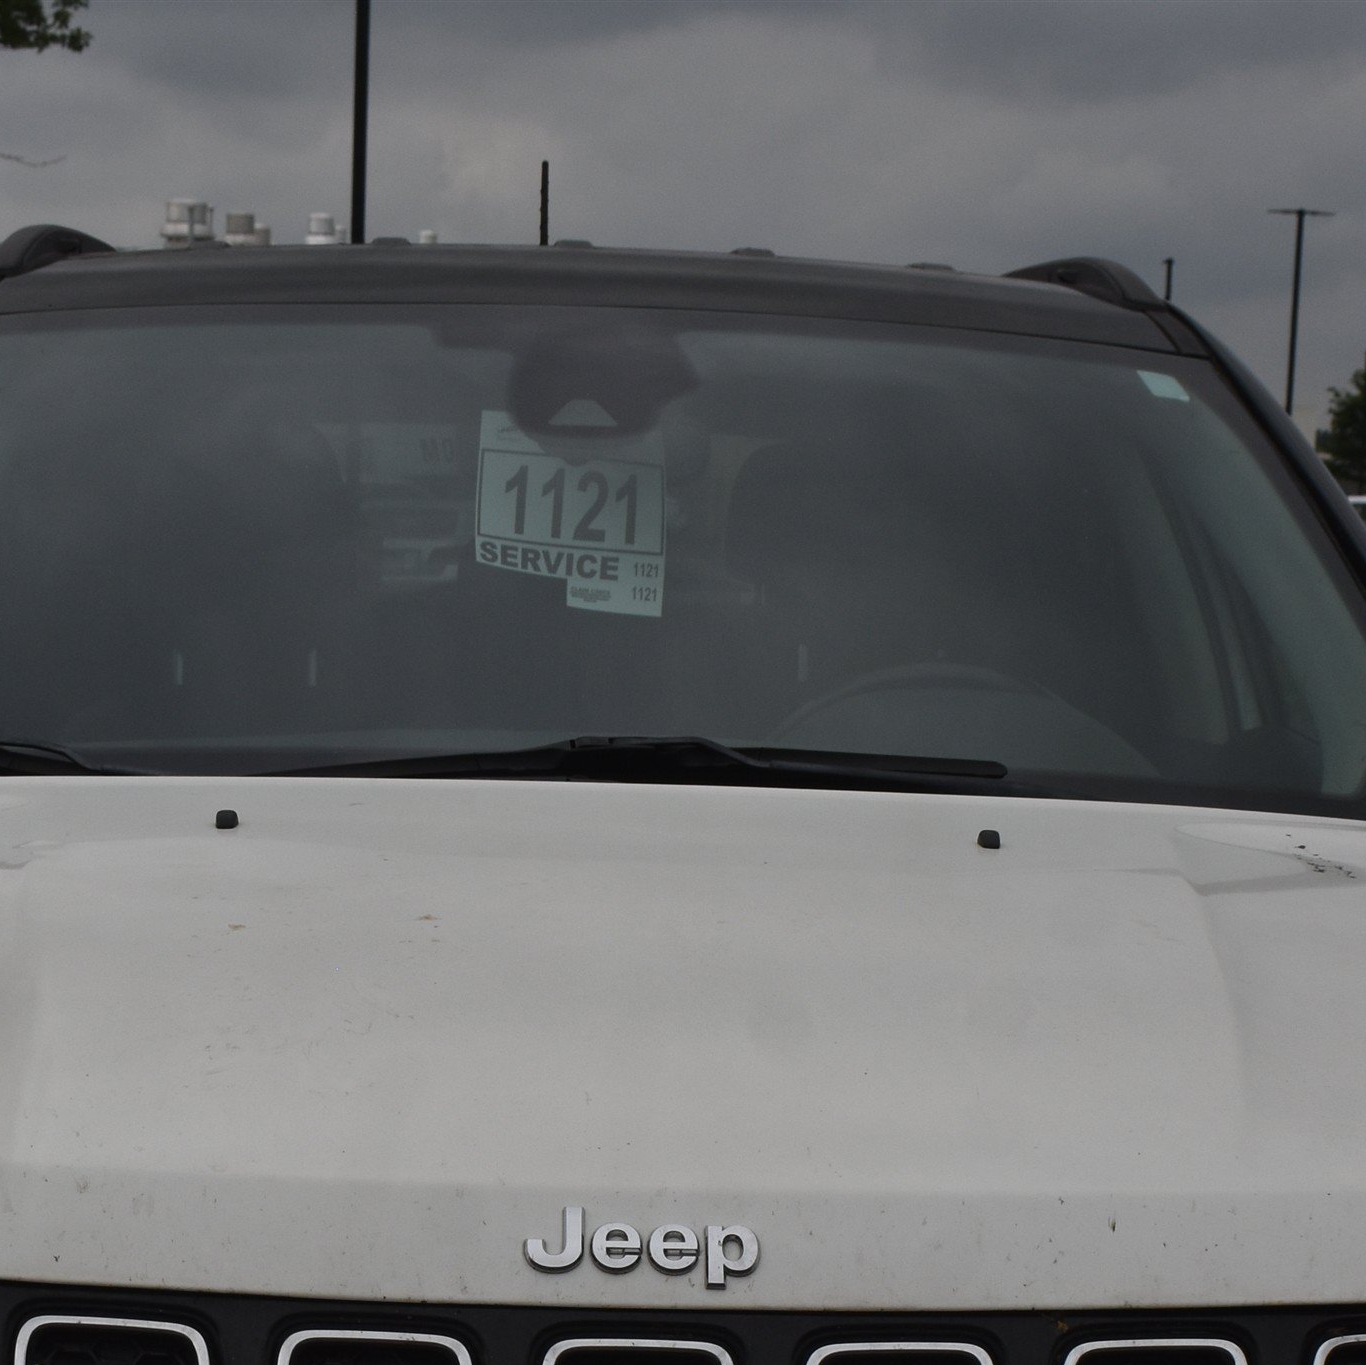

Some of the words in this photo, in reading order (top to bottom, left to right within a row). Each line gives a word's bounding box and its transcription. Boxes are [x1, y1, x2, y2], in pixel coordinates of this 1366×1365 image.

[505, 465, 637, 545] 1121
[480, 541, 619, 580] SERVICE
[633, 562, 659, 578] 1121
[631, 586, 657, 602] 1121
[523, 1206, 760, 1291] Jeep
